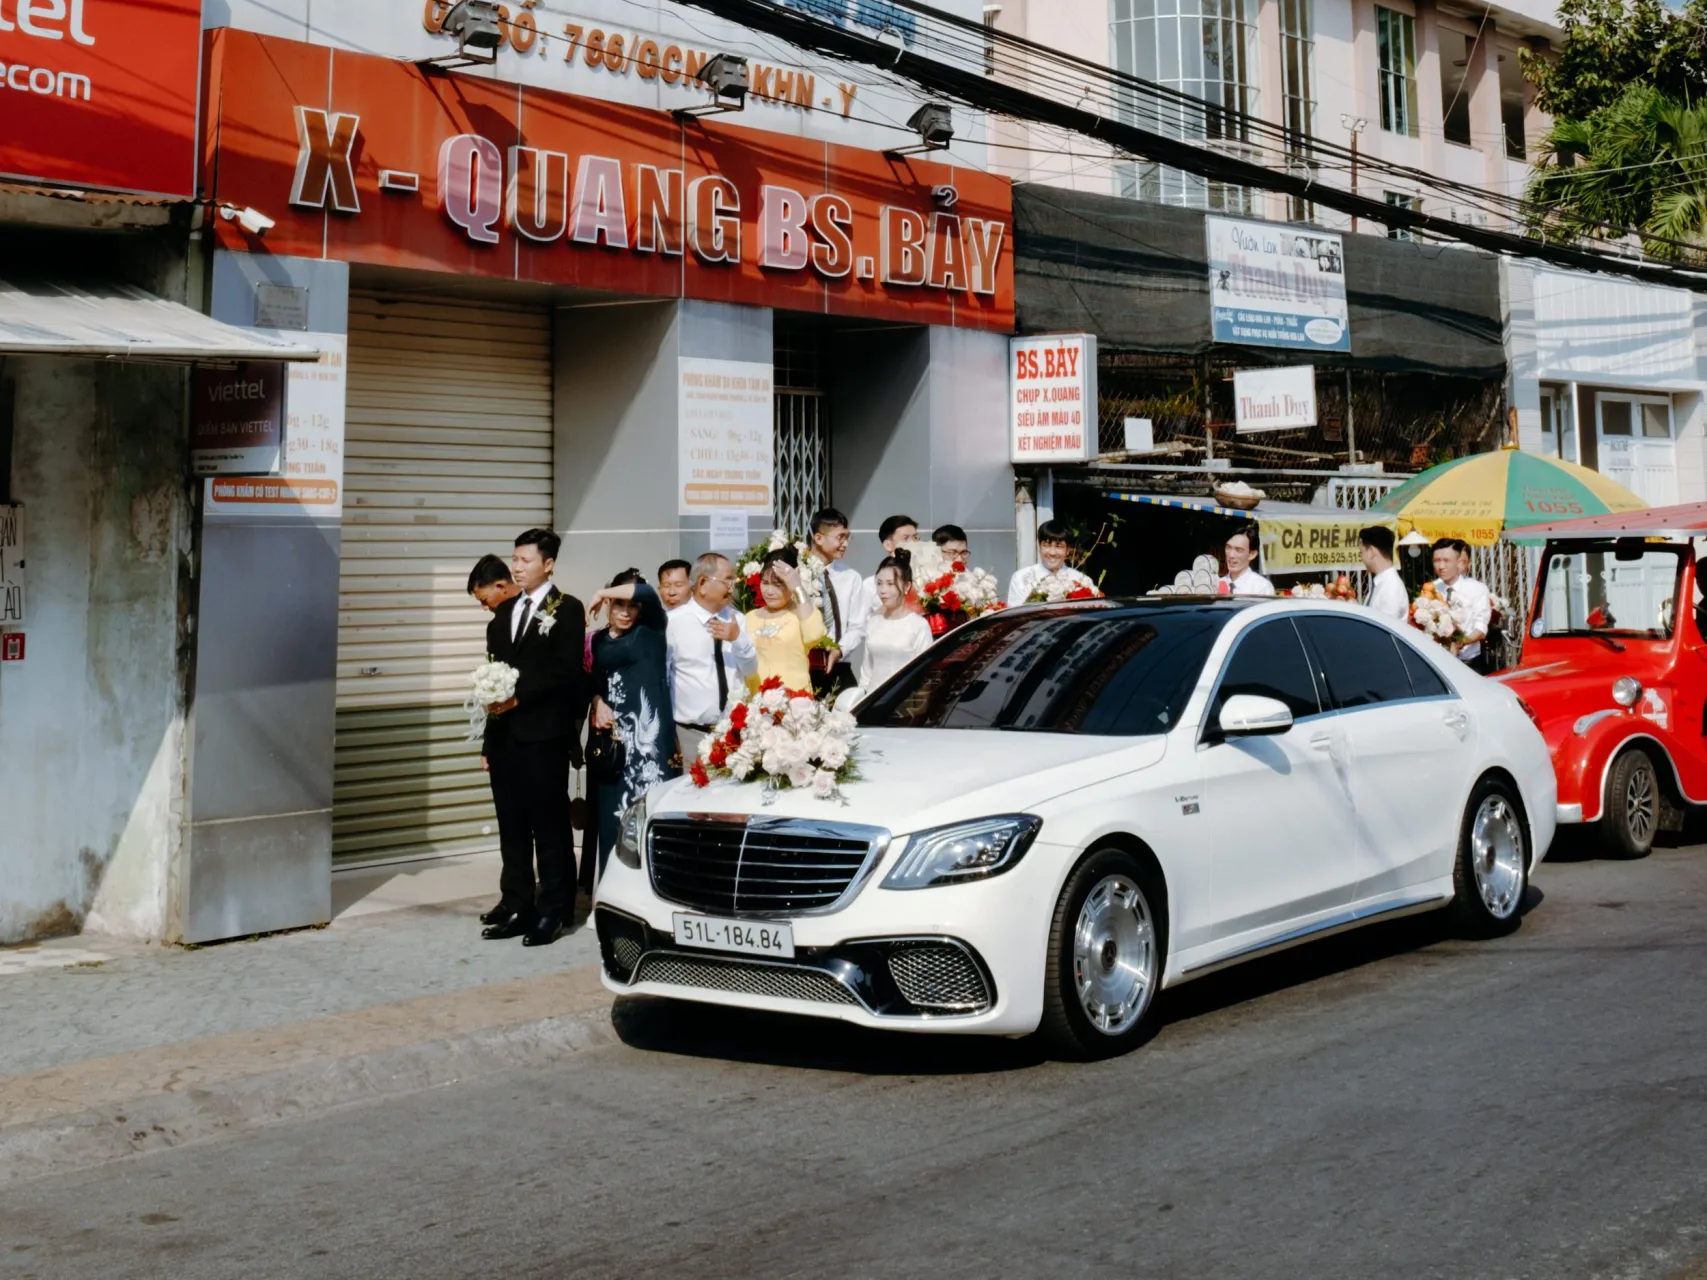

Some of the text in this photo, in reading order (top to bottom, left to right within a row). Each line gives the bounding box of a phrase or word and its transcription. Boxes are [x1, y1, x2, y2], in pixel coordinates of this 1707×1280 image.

[838, 81, 857, 119] Y
[288, 105, 361, 213] X
[437, 133, 741, 265] QUANG
[757, 184, 1005, 296] BS.BẢY
[1016, 338, 1079, 380] BS.BẢY
[208, 378, 266, 403] viettel
[1017, 386, 1080, 406] CHỤP X.QUANG
[1017, 410, 1034, 427] SIÊU
[1239, 394, 1310, 422] Thanh Duy
[311, 414, 330, 429] 12g
[320, 439, 339, 455] 18g
[1525, 500, 1584, 515] 1055
[1281, 523, 1304, 549] CÀ
[1309, 524, 1340, 549] PHÊ
[1471, 528, 1495, 540] 1055
[1295, 552, 1310, 565] ĐT:
